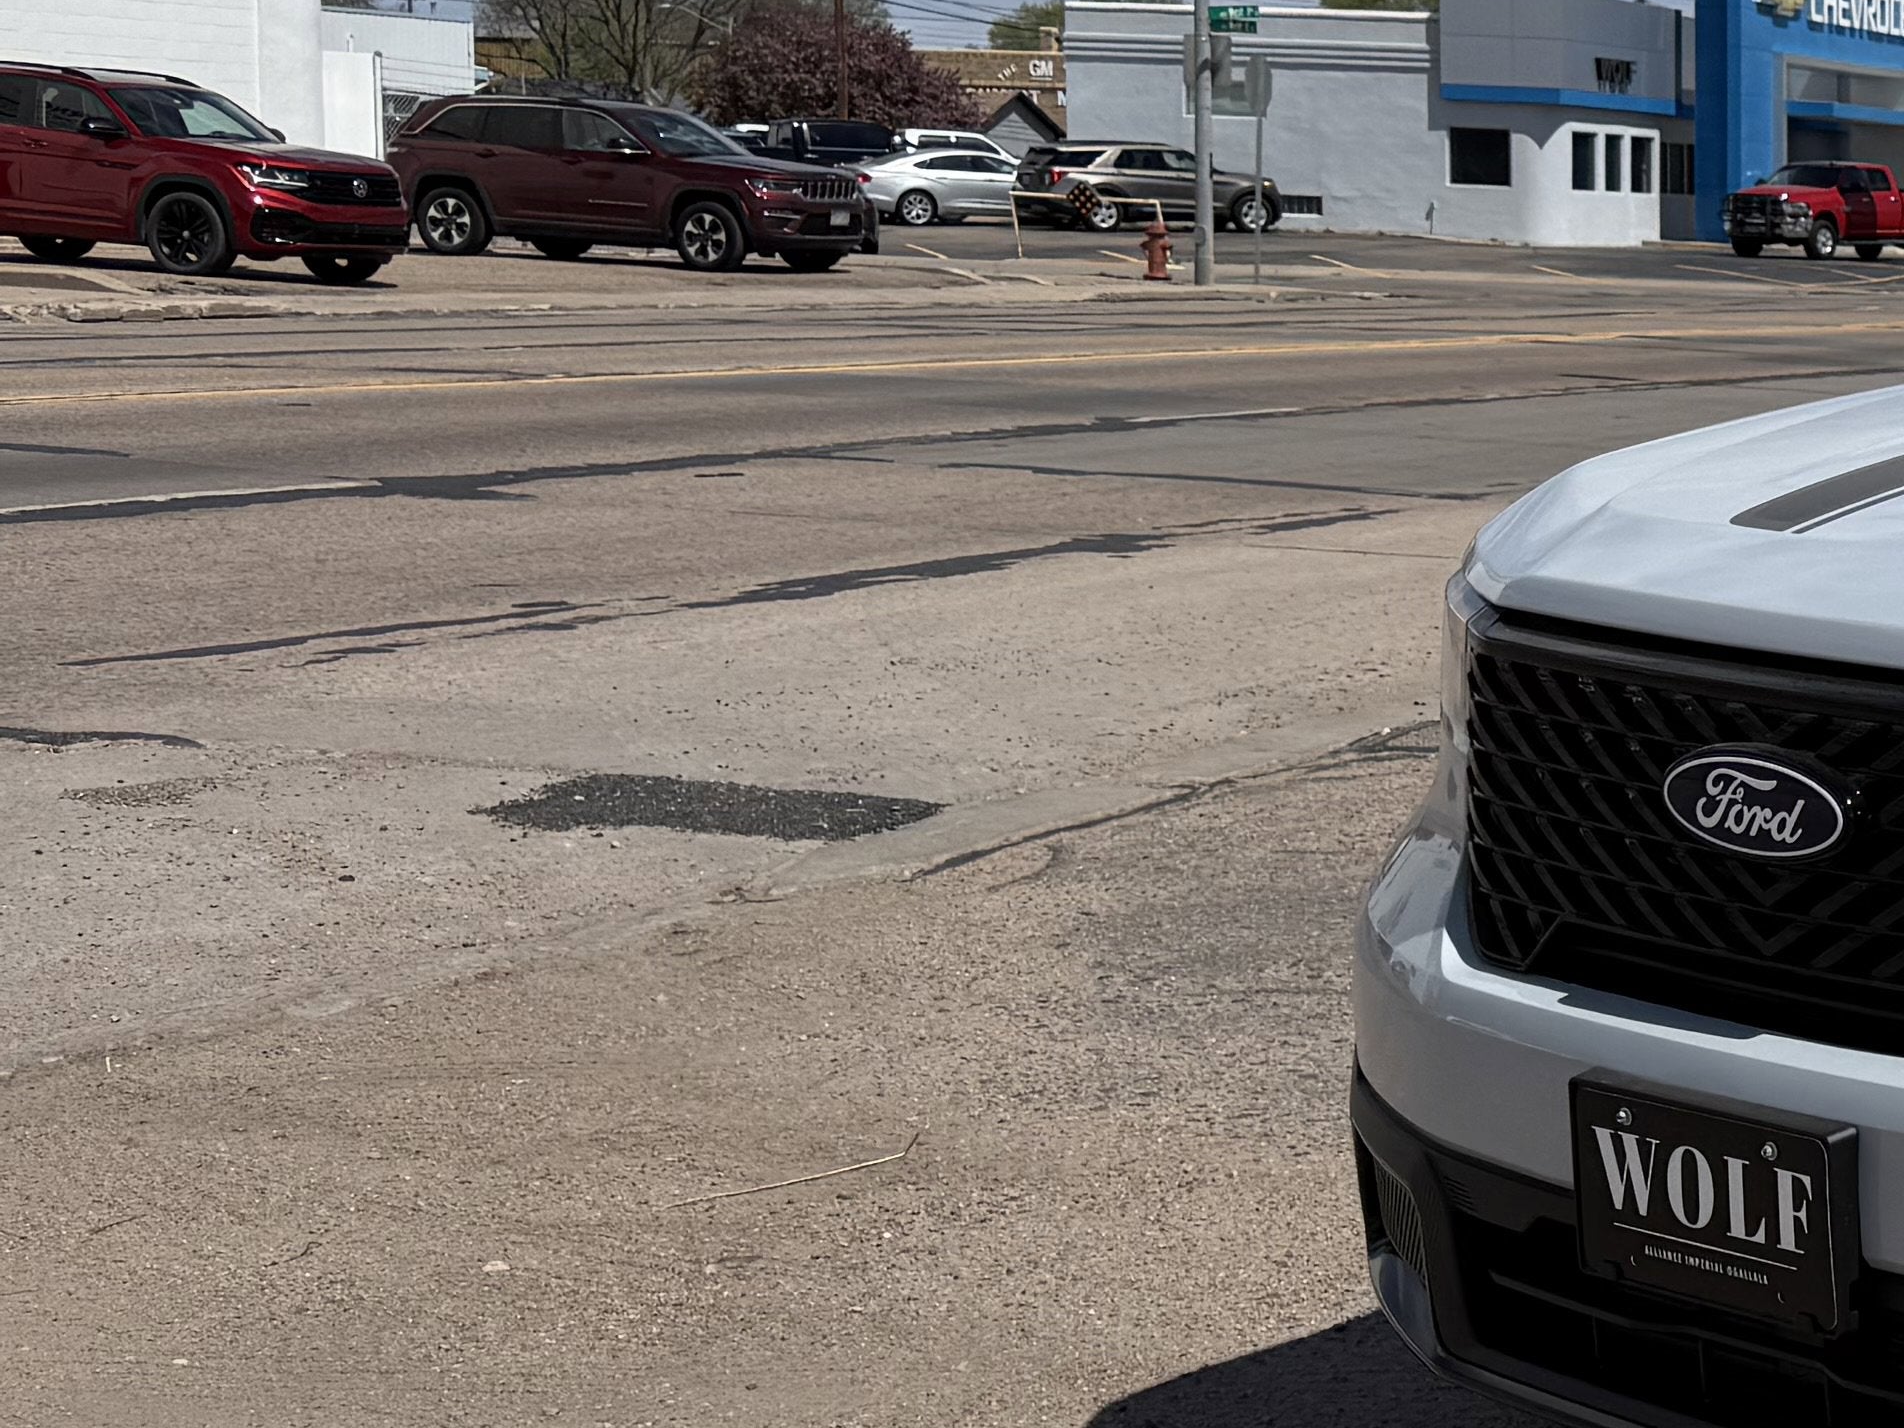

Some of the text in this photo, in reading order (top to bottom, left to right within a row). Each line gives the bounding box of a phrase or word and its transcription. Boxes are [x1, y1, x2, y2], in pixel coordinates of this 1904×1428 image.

[1696, 767, 1805, 844] Ford
[1591, 1125, 1813, 1255] WOLF
[1644, 1244, 1682, 1264] ALLIANCE
[1685, 1254, 1723, 1274] IMPERIAL
